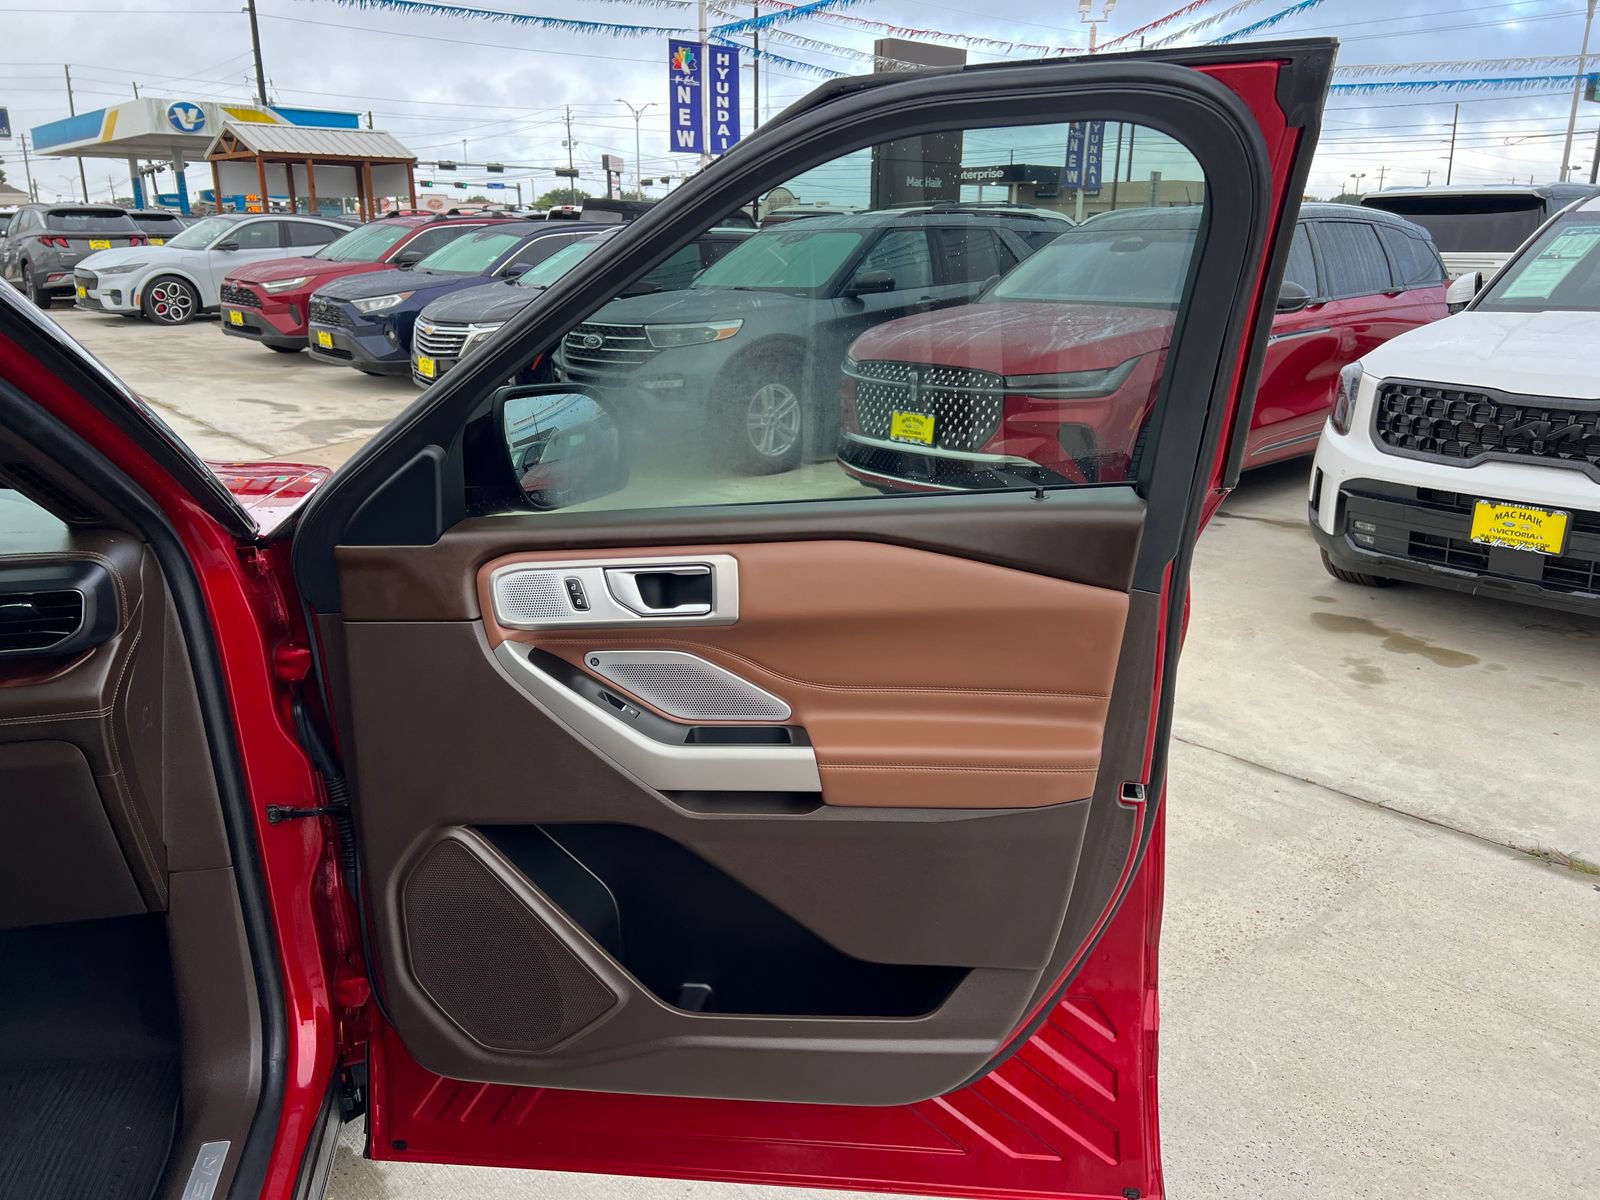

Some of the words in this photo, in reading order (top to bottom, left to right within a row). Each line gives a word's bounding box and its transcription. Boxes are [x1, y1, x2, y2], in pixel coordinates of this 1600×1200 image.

[676, 86, 695, 148] NEW
[716, 53, 731, 149] HYUNDAI
[1066, 139, 1079, 184] NEW
[1089, 122, 1101, 185] YUNDAI
[906, 175, 923, 187] Mac
[925, 176, 942, 188] Haik
[1494, 511, 1517, 521] MAC
[1519, 512, 1543, 528] HAIK
[1496, 528, 1536, 540] VICTORIA
